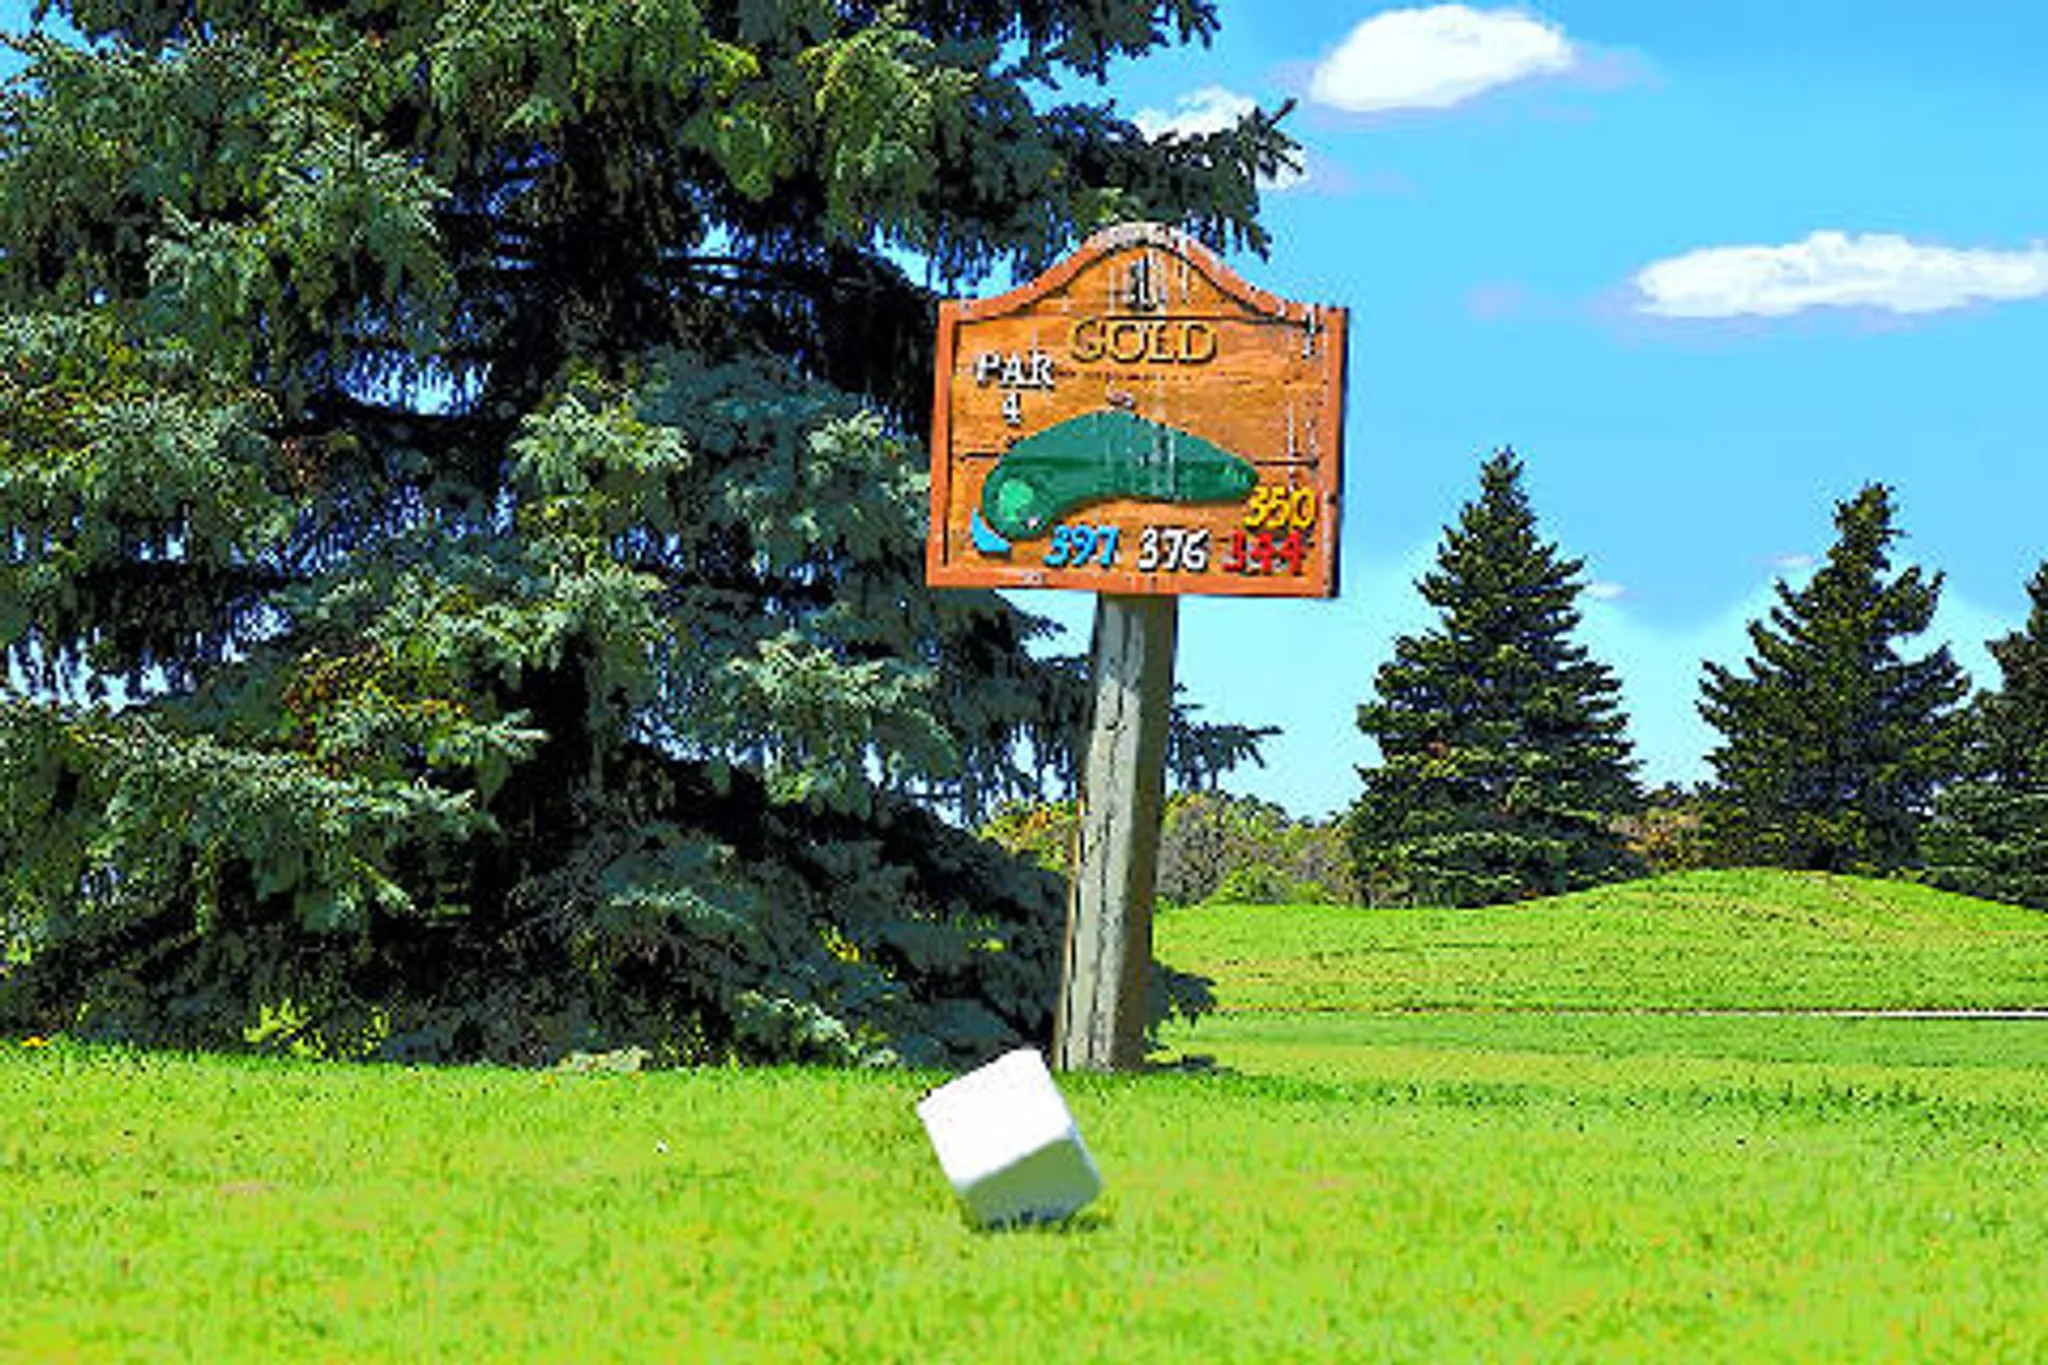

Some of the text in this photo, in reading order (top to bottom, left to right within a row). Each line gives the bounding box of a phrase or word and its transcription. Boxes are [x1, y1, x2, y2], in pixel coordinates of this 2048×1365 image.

[1067, 318, 1217, 364] GOLD
[976, 350, 1055, 389] PAR
[1002, 391, 1021, 426] 4
[1243, 485, 1317, 531] 350
[1043, 523, 1119, 568] 397
[1138, 527, 1210, 572] 376
